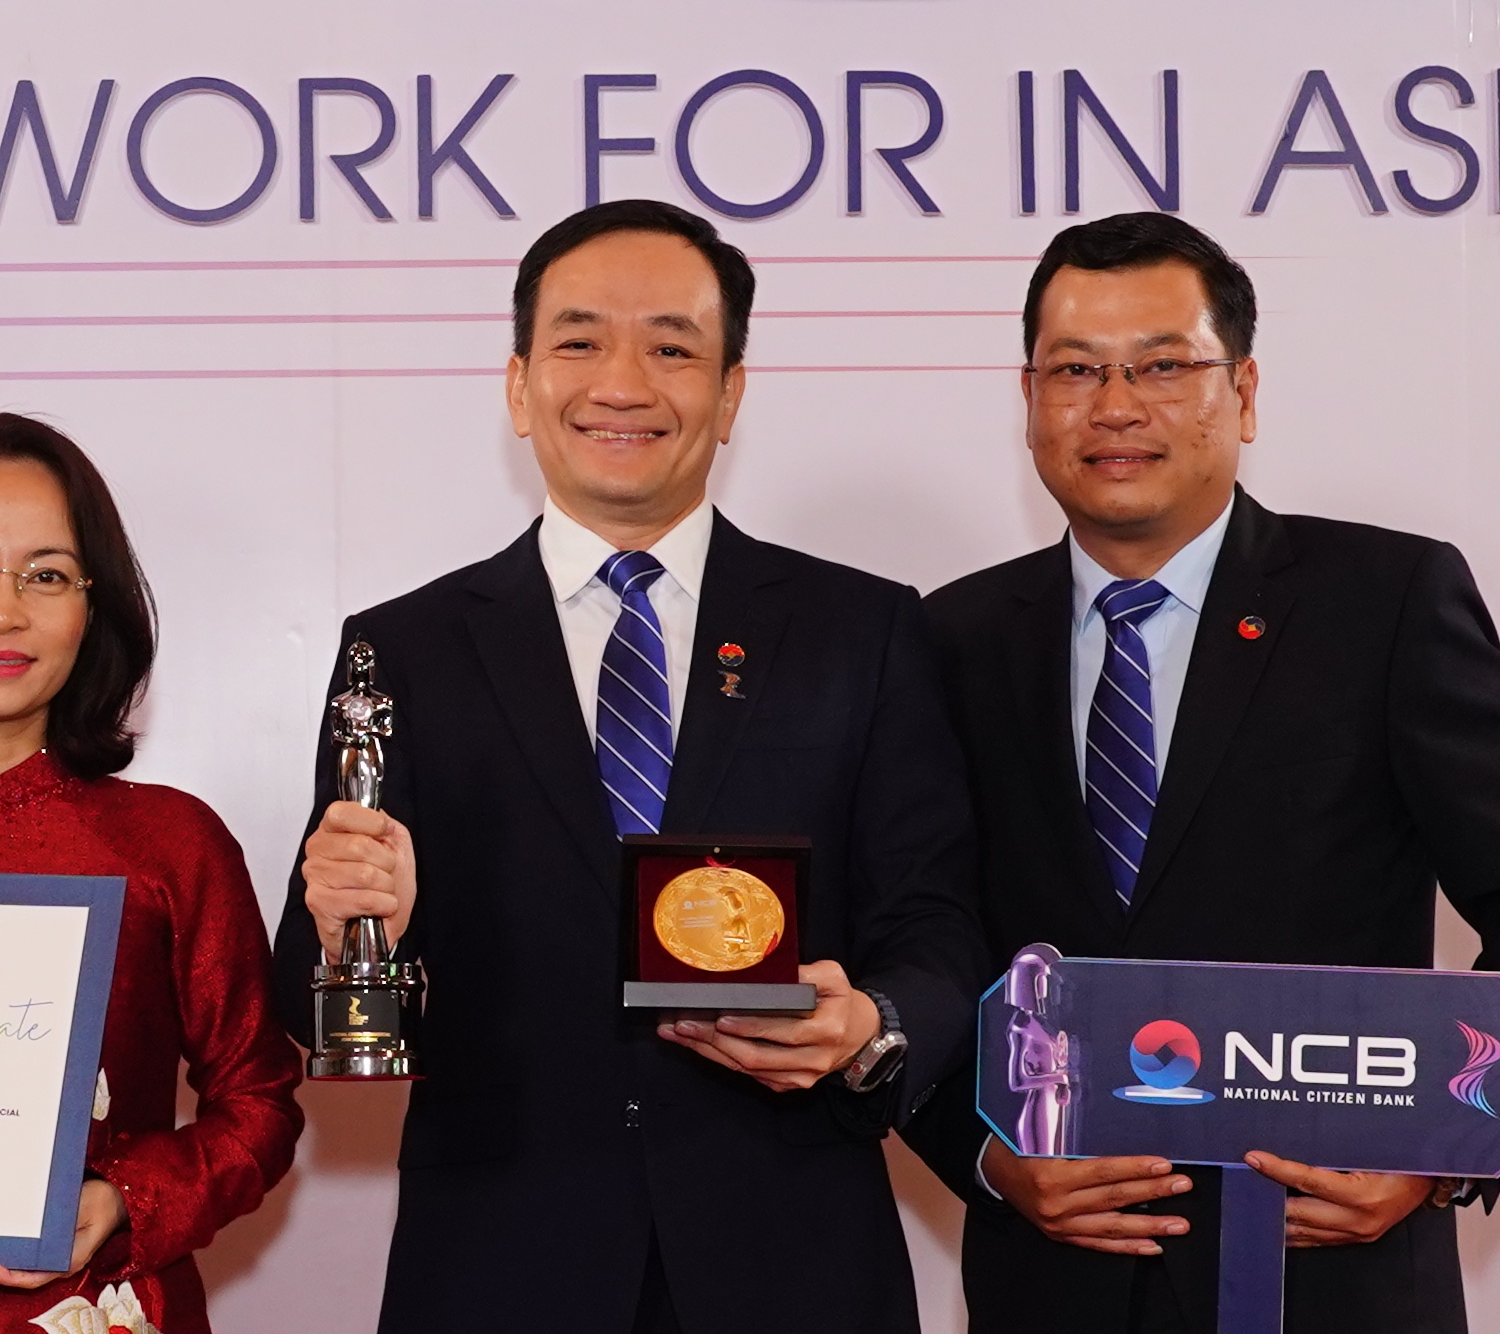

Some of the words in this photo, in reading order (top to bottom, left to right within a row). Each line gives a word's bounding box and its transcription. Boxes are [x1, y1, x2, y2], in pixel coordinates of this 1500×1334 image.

[583, 68, 945, 219] FOR
[1017, 68, 1180, 216] IN
[1223, 1030, 1417, 1088] NCB
[1223, 1087, 1300, 1102] NATIONAL
[1306, 1090, 1366, 1105] CITIZEN
[1373, 1093, 1416, 1108] BANK
